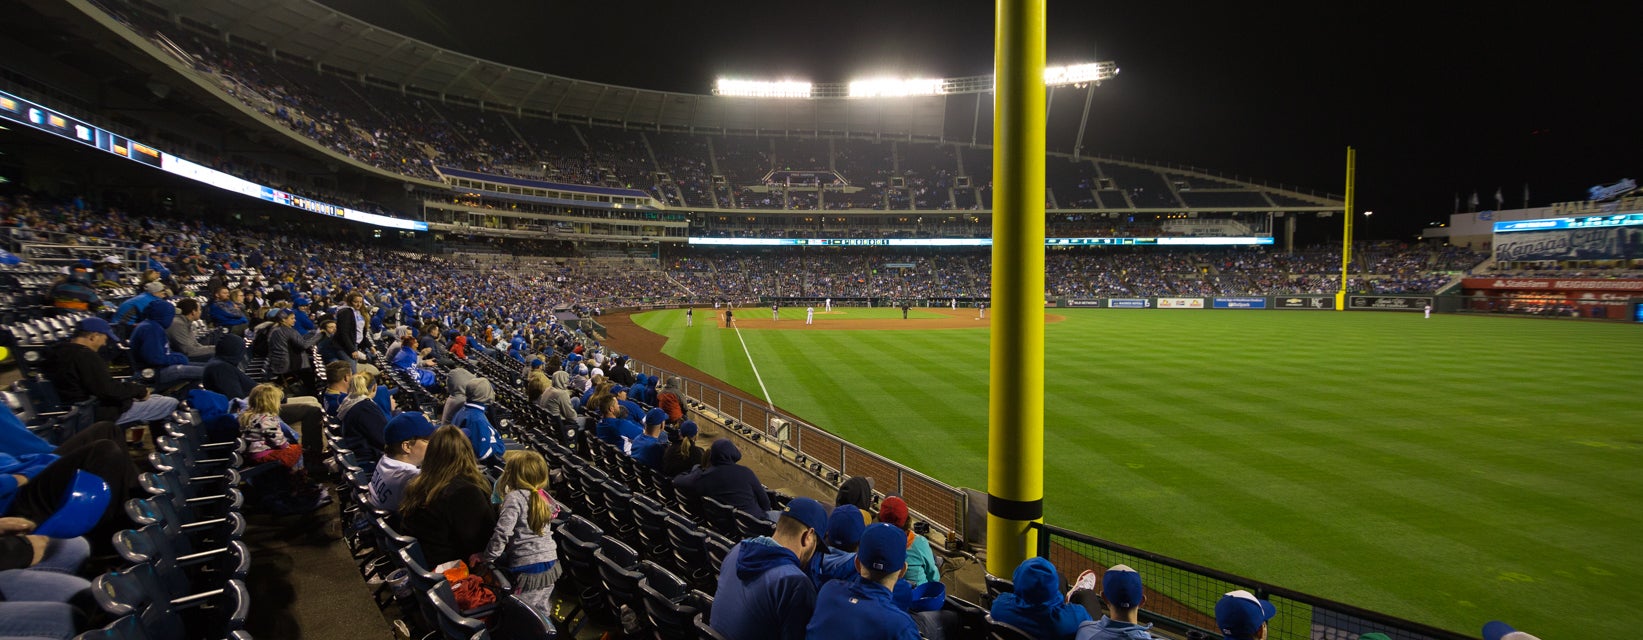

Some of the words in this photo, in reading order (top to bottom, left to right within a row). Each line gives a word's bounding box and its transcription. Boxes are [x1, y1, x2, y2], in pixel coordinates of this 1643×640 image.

[1552, 201, 1601, 215] HALL
[1497, 239, 1566, 259] Kansas
[1567, 229, 1607, 253] City
